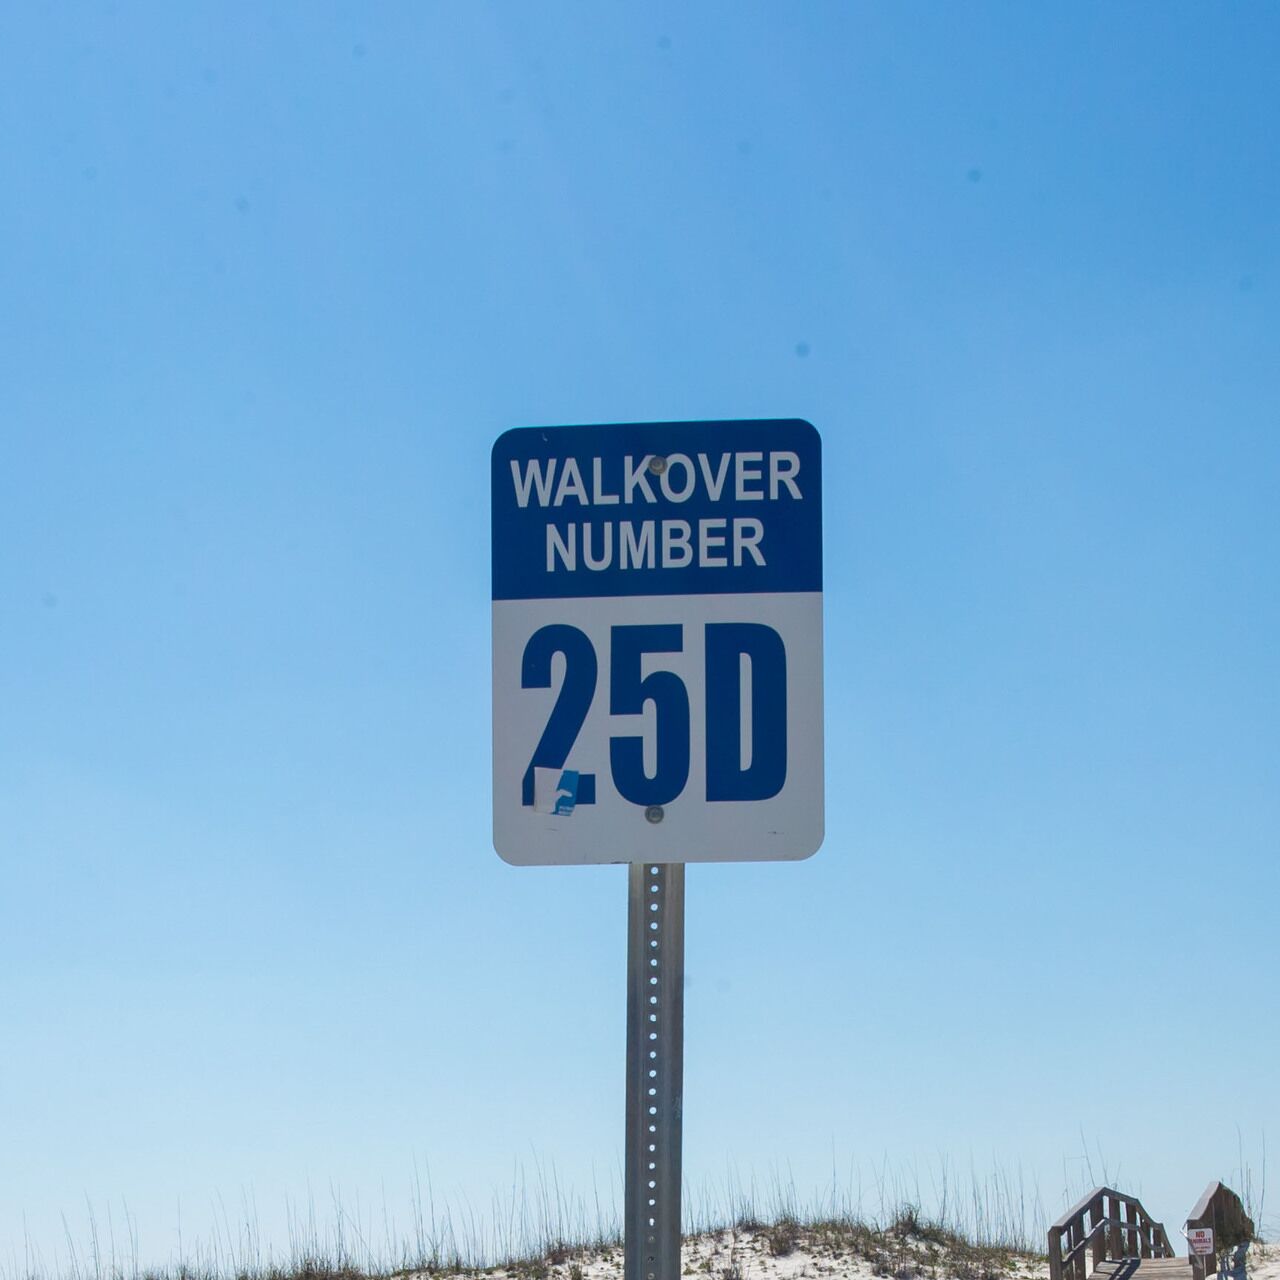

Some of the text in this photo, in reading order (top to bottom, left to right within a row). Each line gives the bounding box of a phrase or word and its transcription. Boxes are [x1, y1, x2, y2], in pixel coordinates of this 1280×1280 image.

[510, 451, 803, 508] WALKOVER
[546, 518, 767, 573] NUMBER
[521, 622, 787, 807] 25D
